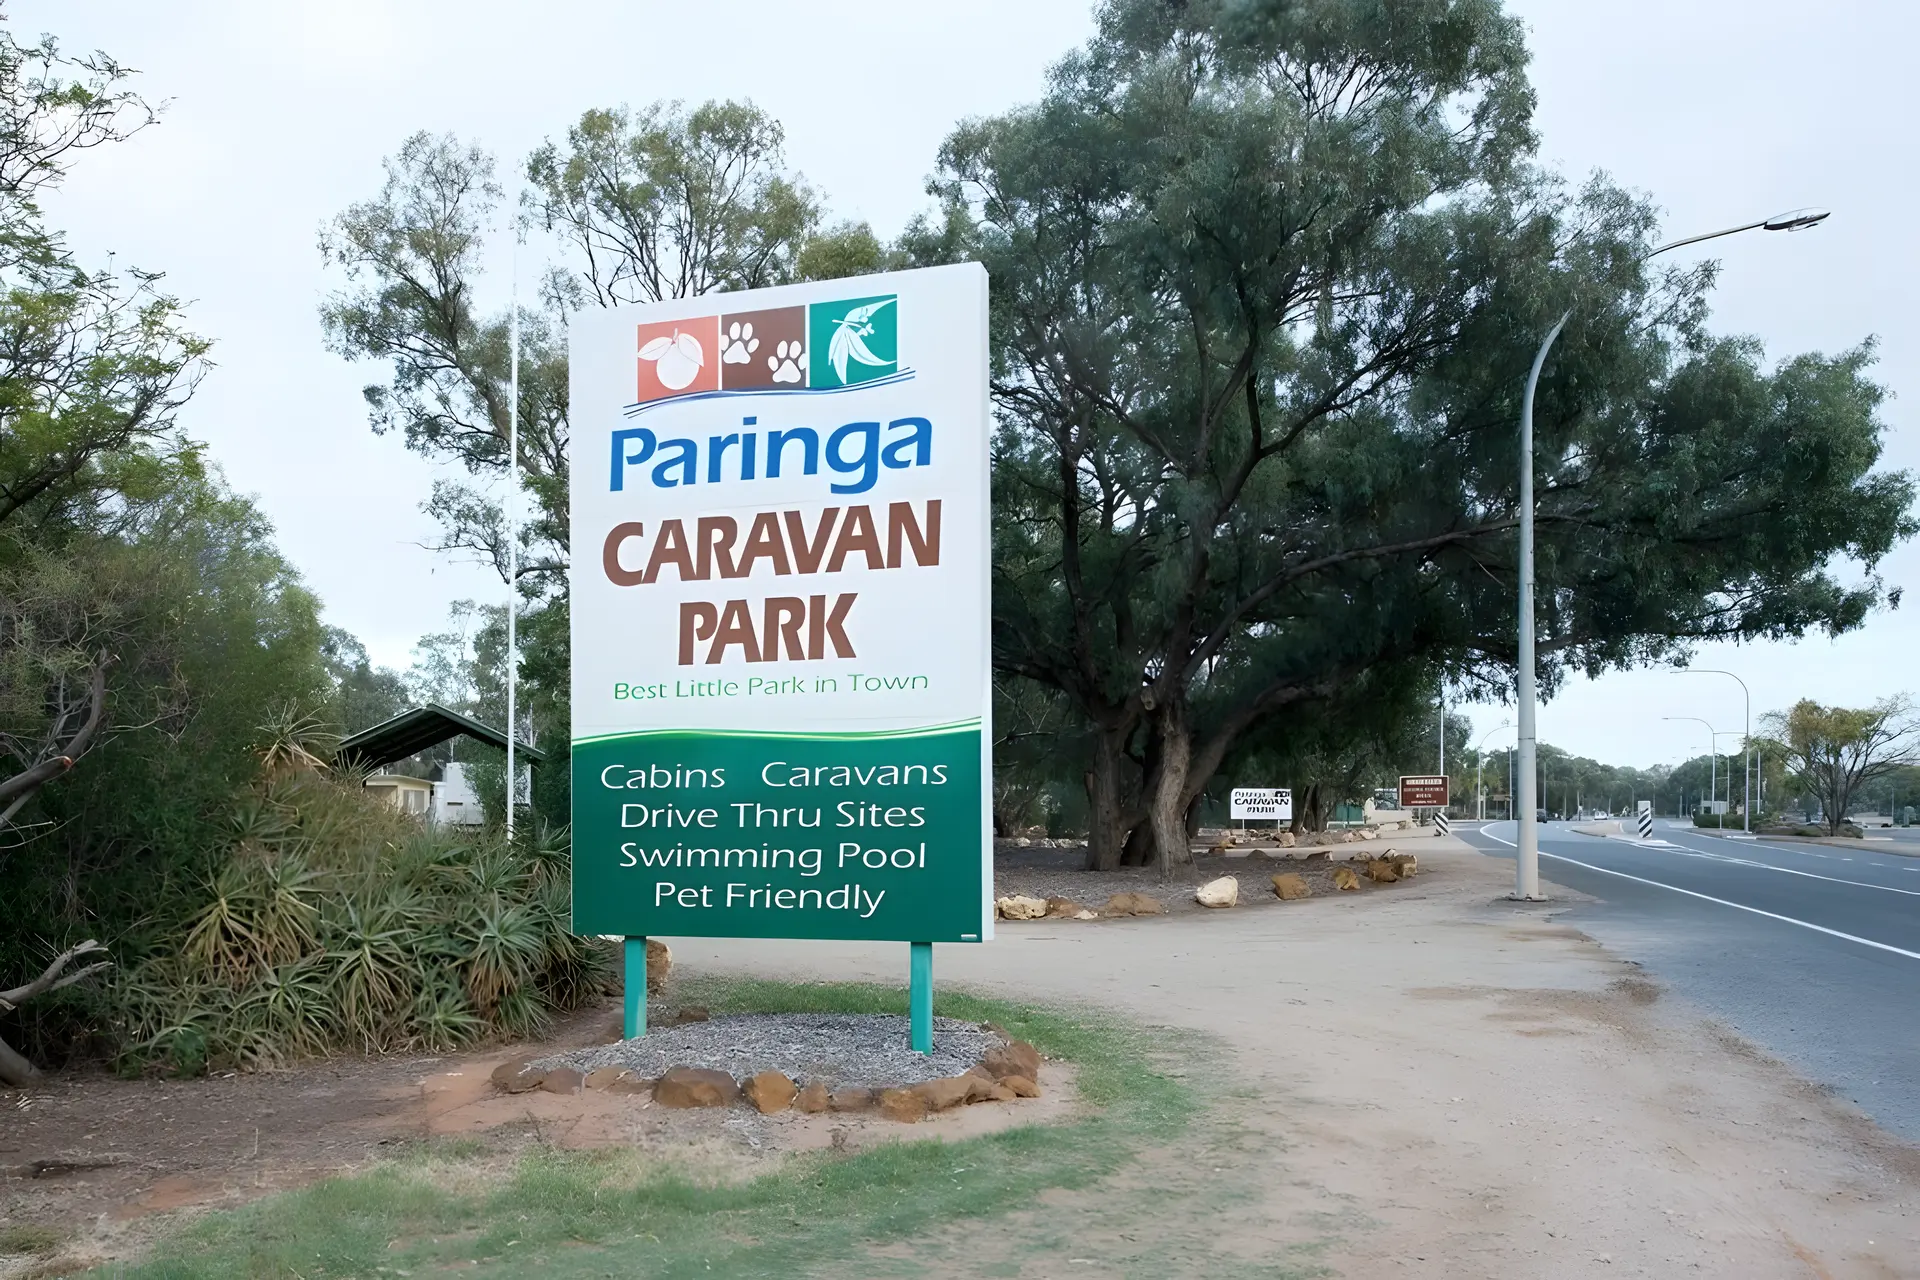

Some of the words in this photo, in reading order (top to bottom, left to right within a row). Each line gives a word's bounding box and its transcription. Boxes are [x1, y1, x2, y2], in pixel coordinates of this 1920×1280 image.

[609, 416, 932, 494] Paringa
[602, 499, 942, 586] CARAVAN
[677, 592, 858, 665] PARK
[614, 682, 667, 700] Best
[675, 679, 739, 697] Little
[748, 676, 805, 696] Park
[815, 675, 837, 693] in
[847, 673, 929, 692] Town
[600, 763, 726, 789] Cabins
[761, 761, 948, 787] Caravans
[621, 803, 719, 828] Drive
[730, 802, 821, 828] Thru
[835, 801, 925, 828] Sites
[619, 842, 822, 876] Swimming
[838, 842, 926, 869] Pool
[655, 882, 714, 908] Pet
[726, 883, 886, 918] Friendly
